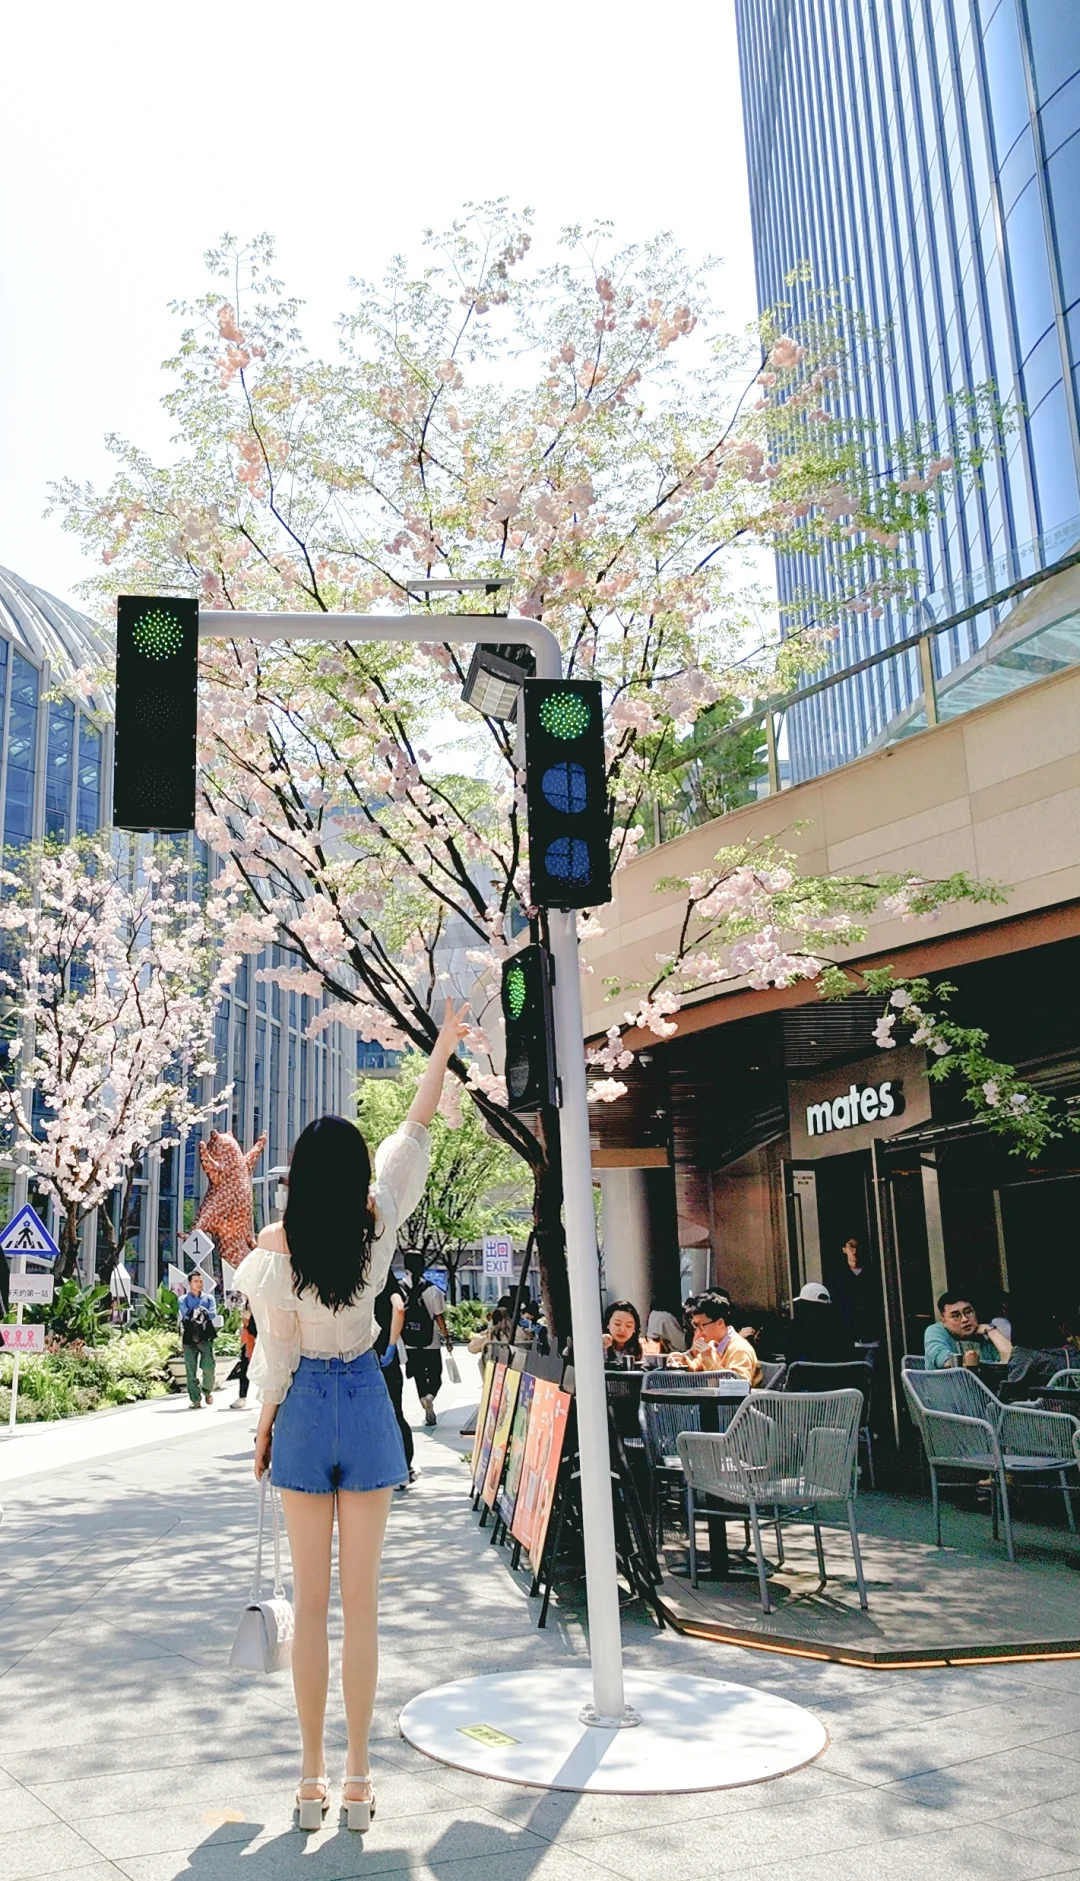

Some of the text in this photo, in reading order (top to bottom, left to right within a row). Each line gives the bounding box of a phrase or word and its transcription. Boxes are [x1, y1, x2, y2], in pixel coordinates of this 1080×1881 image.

[806, 1081, 895, 1136] mates
[192, 1237, 201, 1255] 1
[486, 1260, 508, 1272] EXIT
[9, 1289, 49, 1298] 天的第一站
